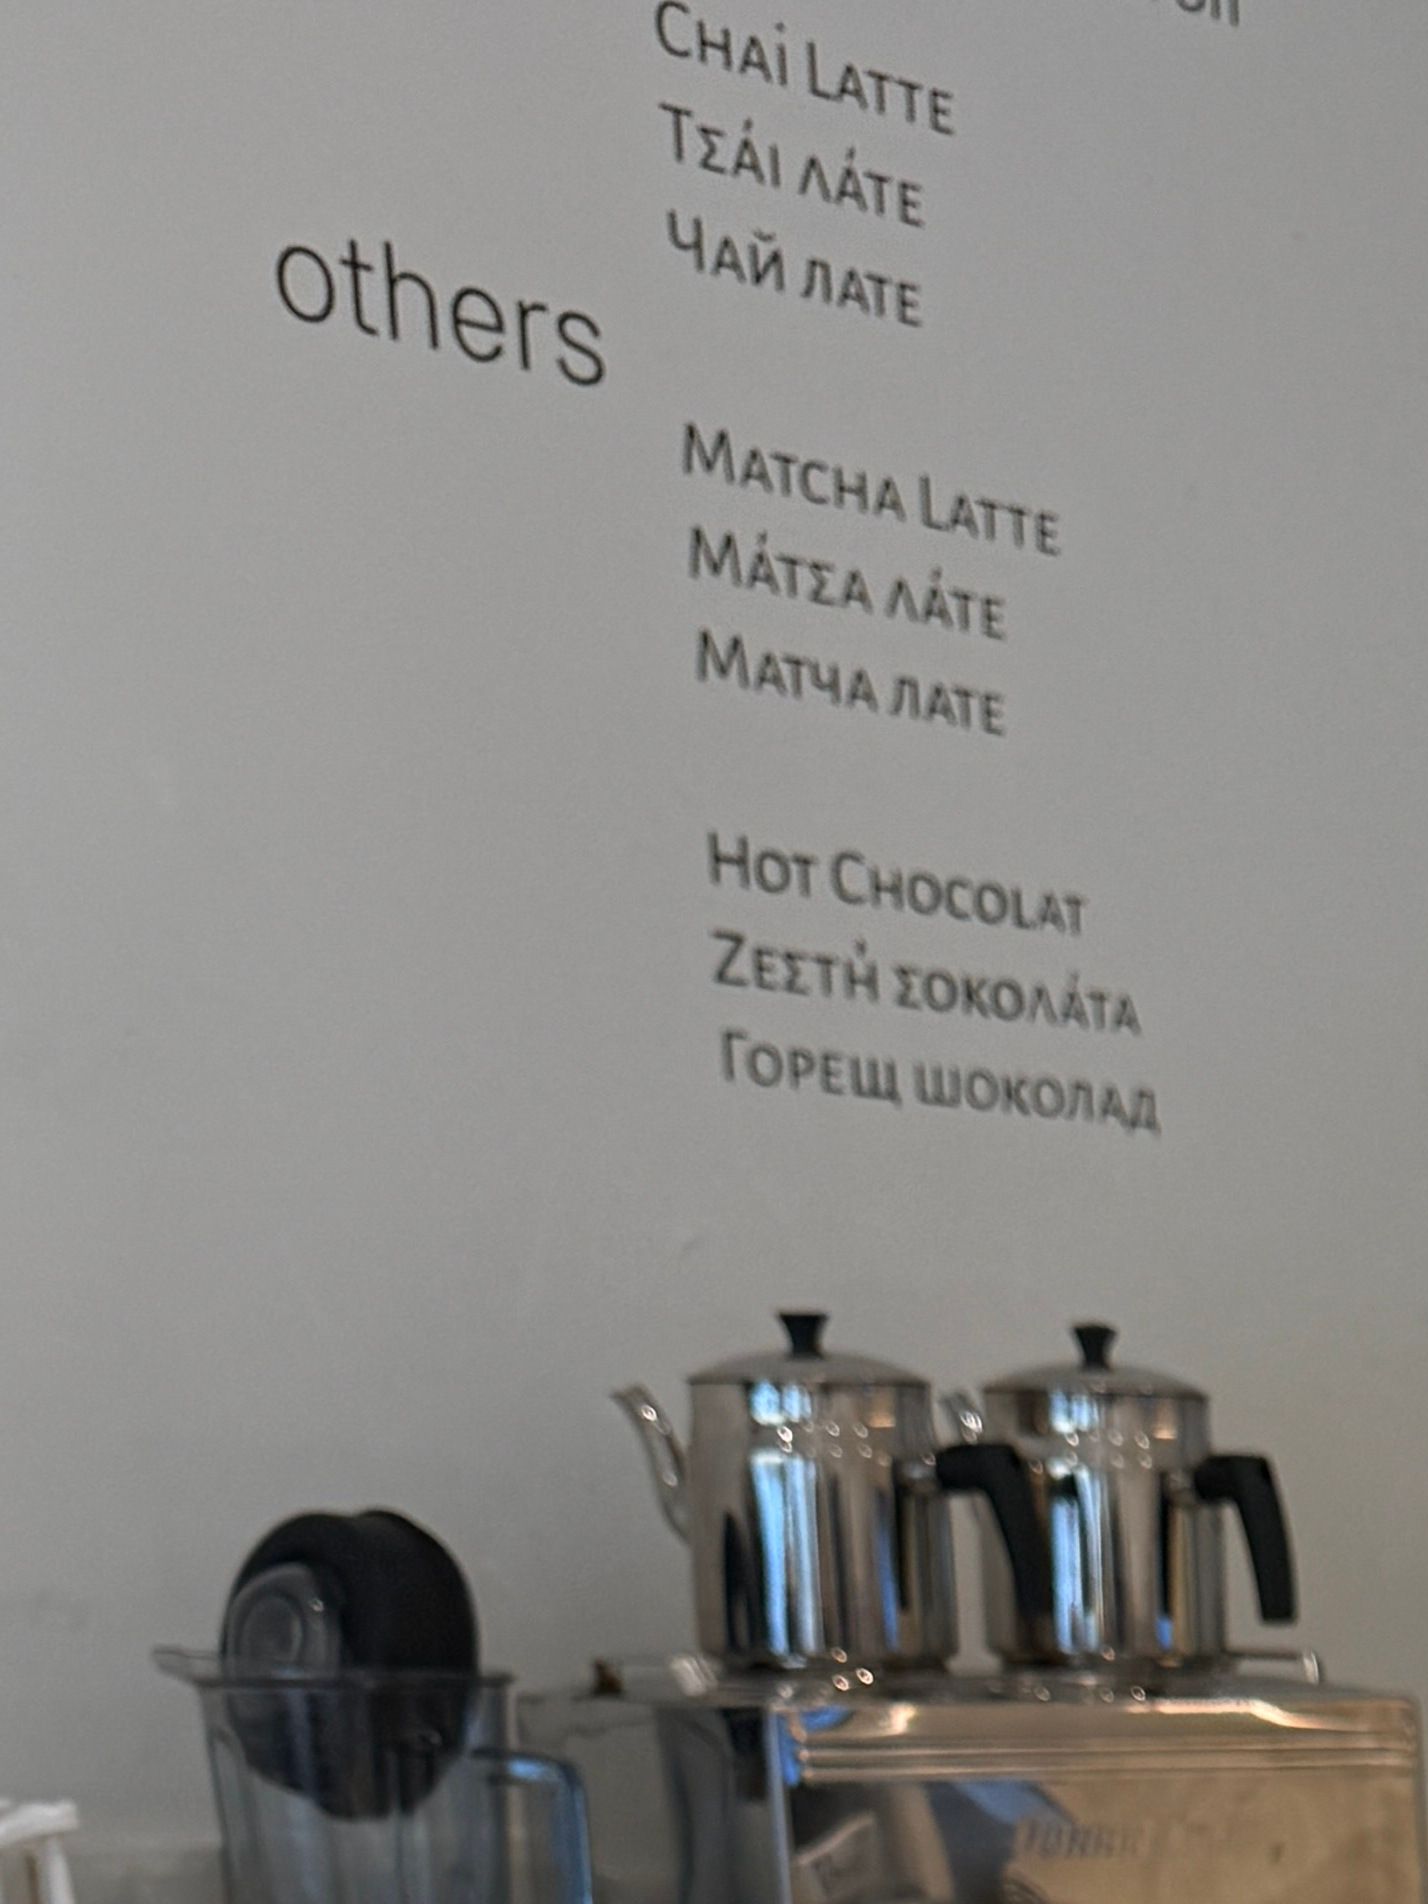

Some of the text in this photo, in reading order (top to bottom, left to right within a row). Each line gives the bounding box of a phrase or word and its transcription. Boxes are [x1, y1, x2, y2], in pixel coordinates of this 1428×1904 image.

[806, 40, 956, 136] LATTE
[667, 208, 786, 293] ЧАЙ
[275, 238, 606, 387] others
[682, 420, 1061, 557] MATCHA LATTE
[707, 831, 1090, 936] HOT CHOCOLAT
